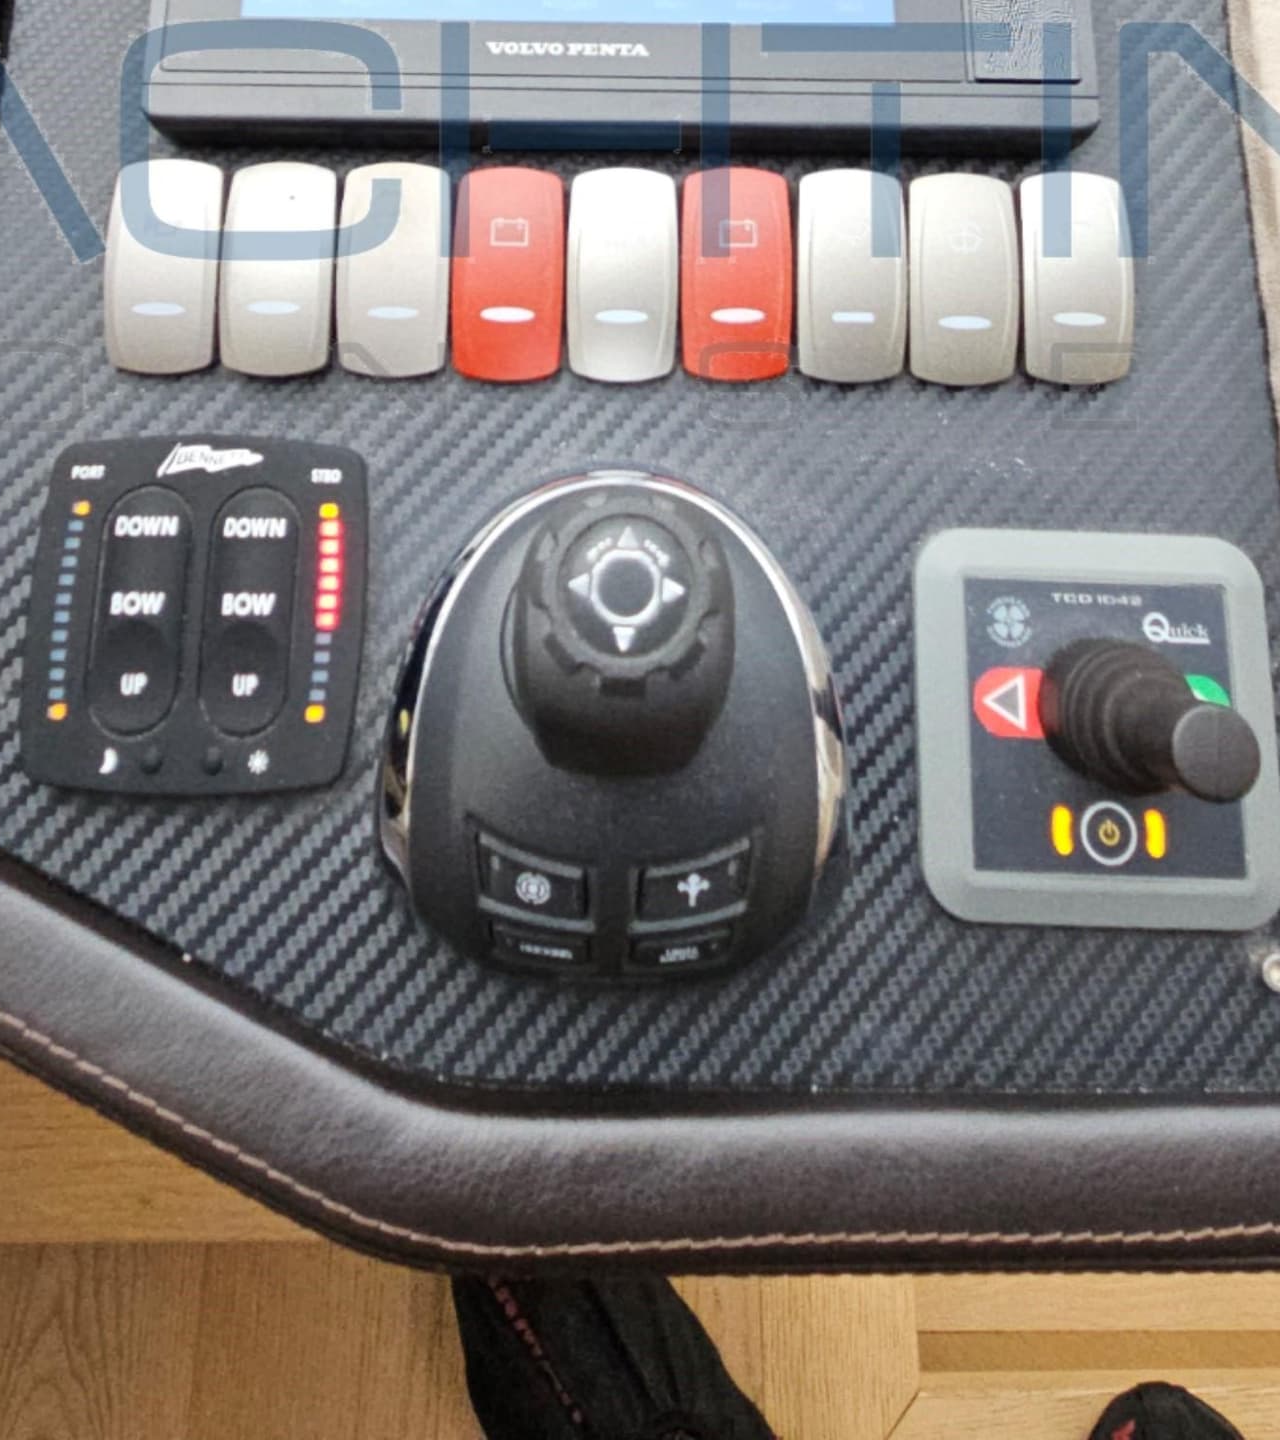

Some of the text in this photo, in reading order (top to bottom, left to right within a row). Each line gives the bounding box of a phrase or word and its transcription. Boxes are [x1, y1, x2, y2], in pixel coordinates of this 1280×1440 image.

[485, 41, 650, 57] VOLVO PENTA
[114, 515, 179, 537] DOWN
[222, 517, 287, 538] DOWN
[110, 591, 166, 616] BOW
[221, 592, 276, 616] BOW
[1051, 592, 1093, 604] TCD
[1142, 611, 1211, 644] Quick
[120, 672, 148, 696] UP
[232, 673, 259, 696] UP
